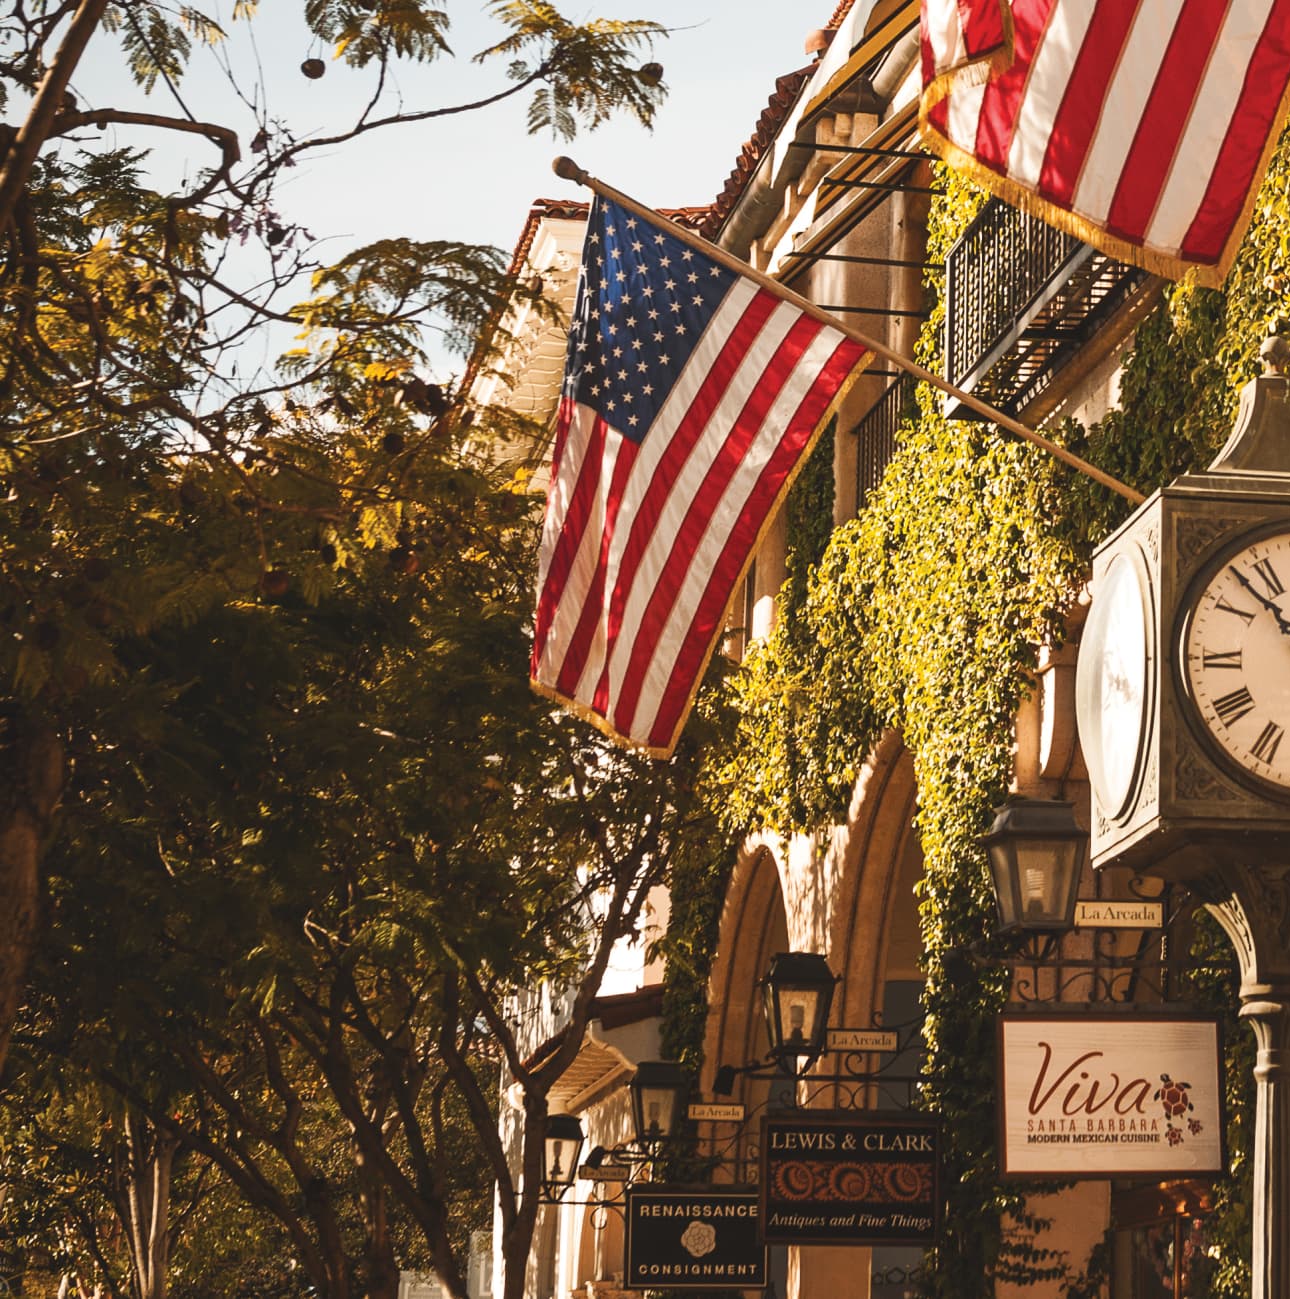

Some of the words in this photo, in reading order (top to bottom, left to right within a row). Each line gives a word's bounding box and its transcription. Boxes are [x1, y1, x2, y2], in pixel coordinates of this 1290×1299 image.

[1249, 556, 1287, 601] XI
[1214, 594, 1256, 628] X
[1202, 645, 1243, 673] IX
[1210, 684, 1256, 730] VIII
[1249, 720, 1286, 767] VII
[1081, 905, 1100, 920] La
[1103, 906, 1155, 920] Arcada
[832, 1033, 848, 1045] La
[850, 1034, 891, 1046] Arcada
[1028, 1041, 1152, 1116] Viva
[692, 1106, 705, 1116] La
[1027, 1119, 1077, 1132] SANTA
[1087, 1119, 1159, 1132] BARBARA
[771, 1132, 836, 1150] LEWIS
[841, 1134, 857, 1150] &
[863, 1134, 933, 1151] CLARK
[1027, 1134, 1070, 1143] MODERN
[1072, 1134, 1118, 1143] MEXICAN
[1120, 1134, 1160, 1143] CUISINE
[640, 1205, 758, 1217] RENAISSANCE
[769, 1212, 826, 1228] Antiques
[829, 1214, 855, 1227] and
[858, 1214, 887, 1227] Fine
[890, 1214, 932, 1230] Things
[638, 1264, 757, 1275] CONSIGNMENT
